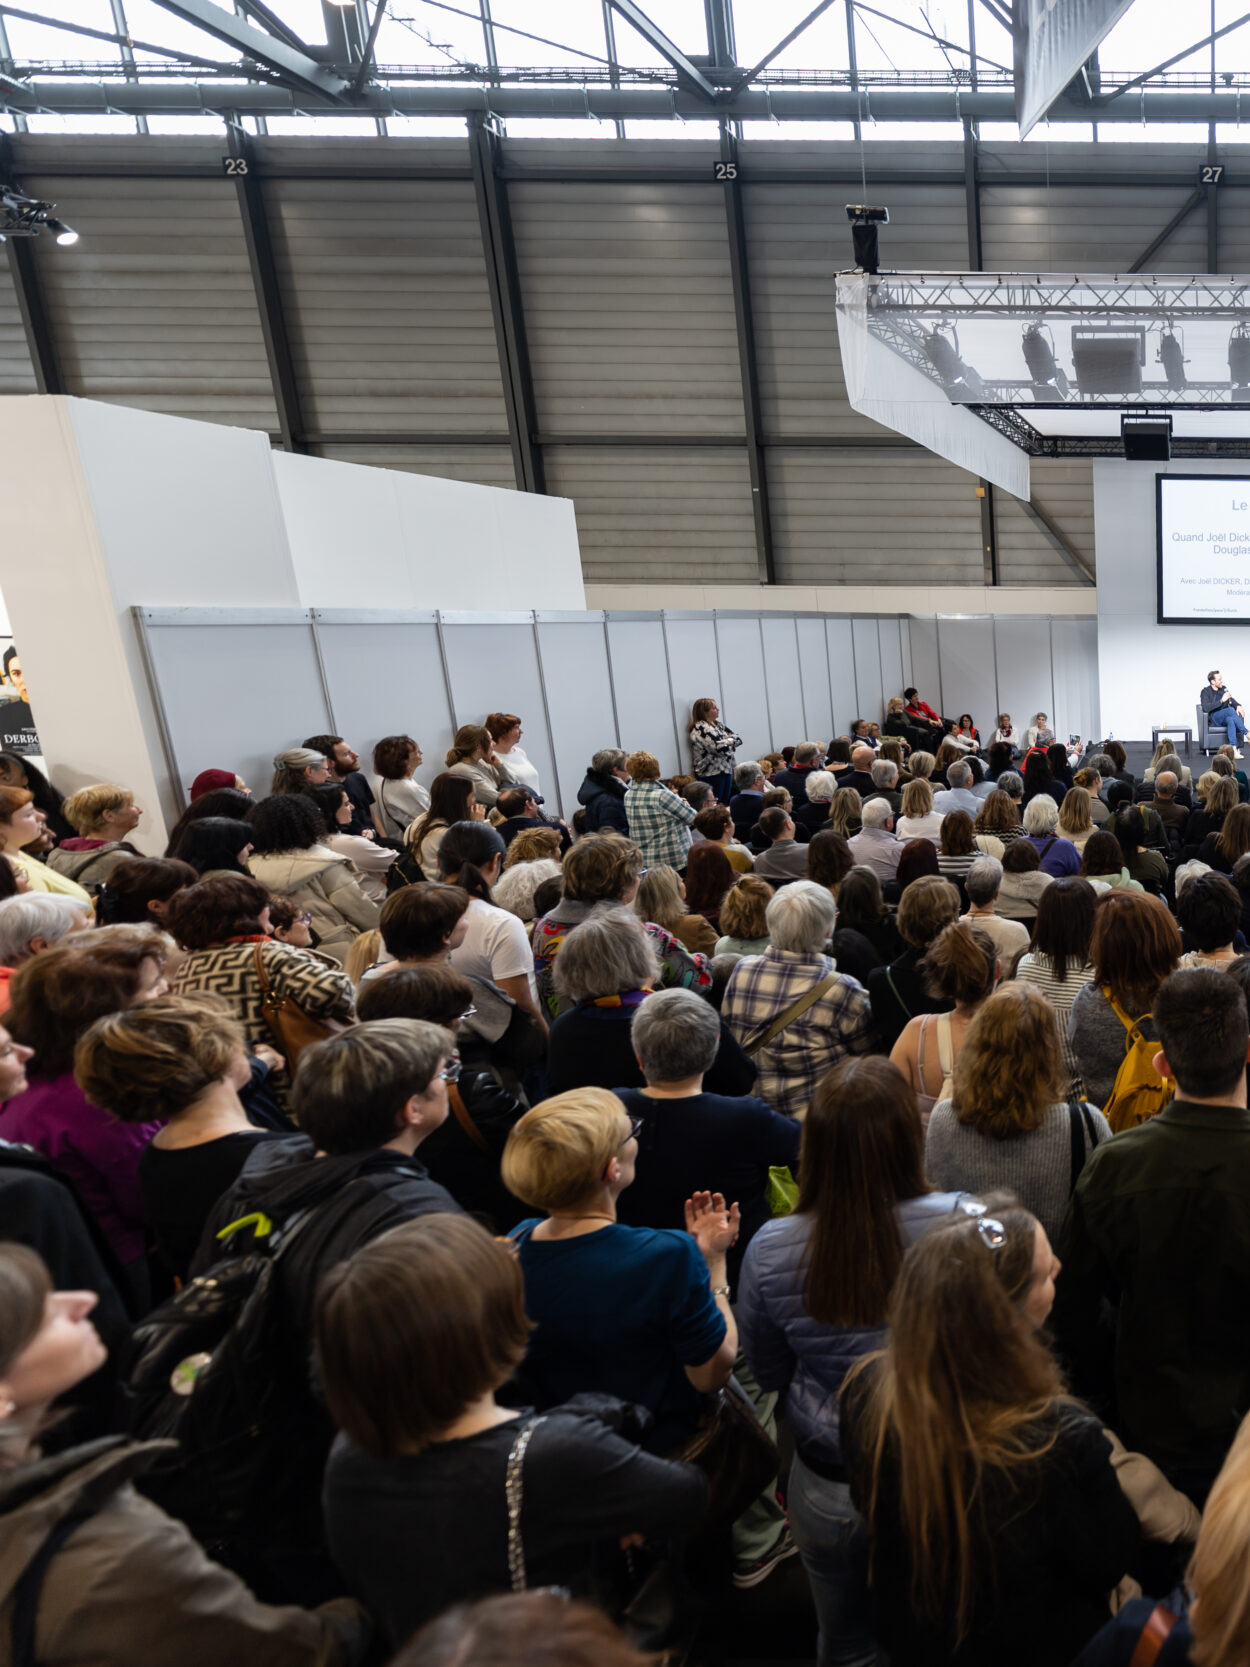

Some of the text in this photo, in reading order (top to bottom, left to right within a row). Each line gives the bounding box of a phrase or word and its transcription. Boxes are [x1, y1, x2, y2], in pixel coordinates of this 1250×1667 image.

[225, 158, 248, 174] 23
[715, 163, 737, 179] 25
[1202, 167, 1223, 183] 27
[1232, 499, 1248, 511] Le
[1172, 532, 1204, 543] Quand
[1206, 532, 1227, 543] Joël
[1213, 578, 1243, 586] DICKER,
